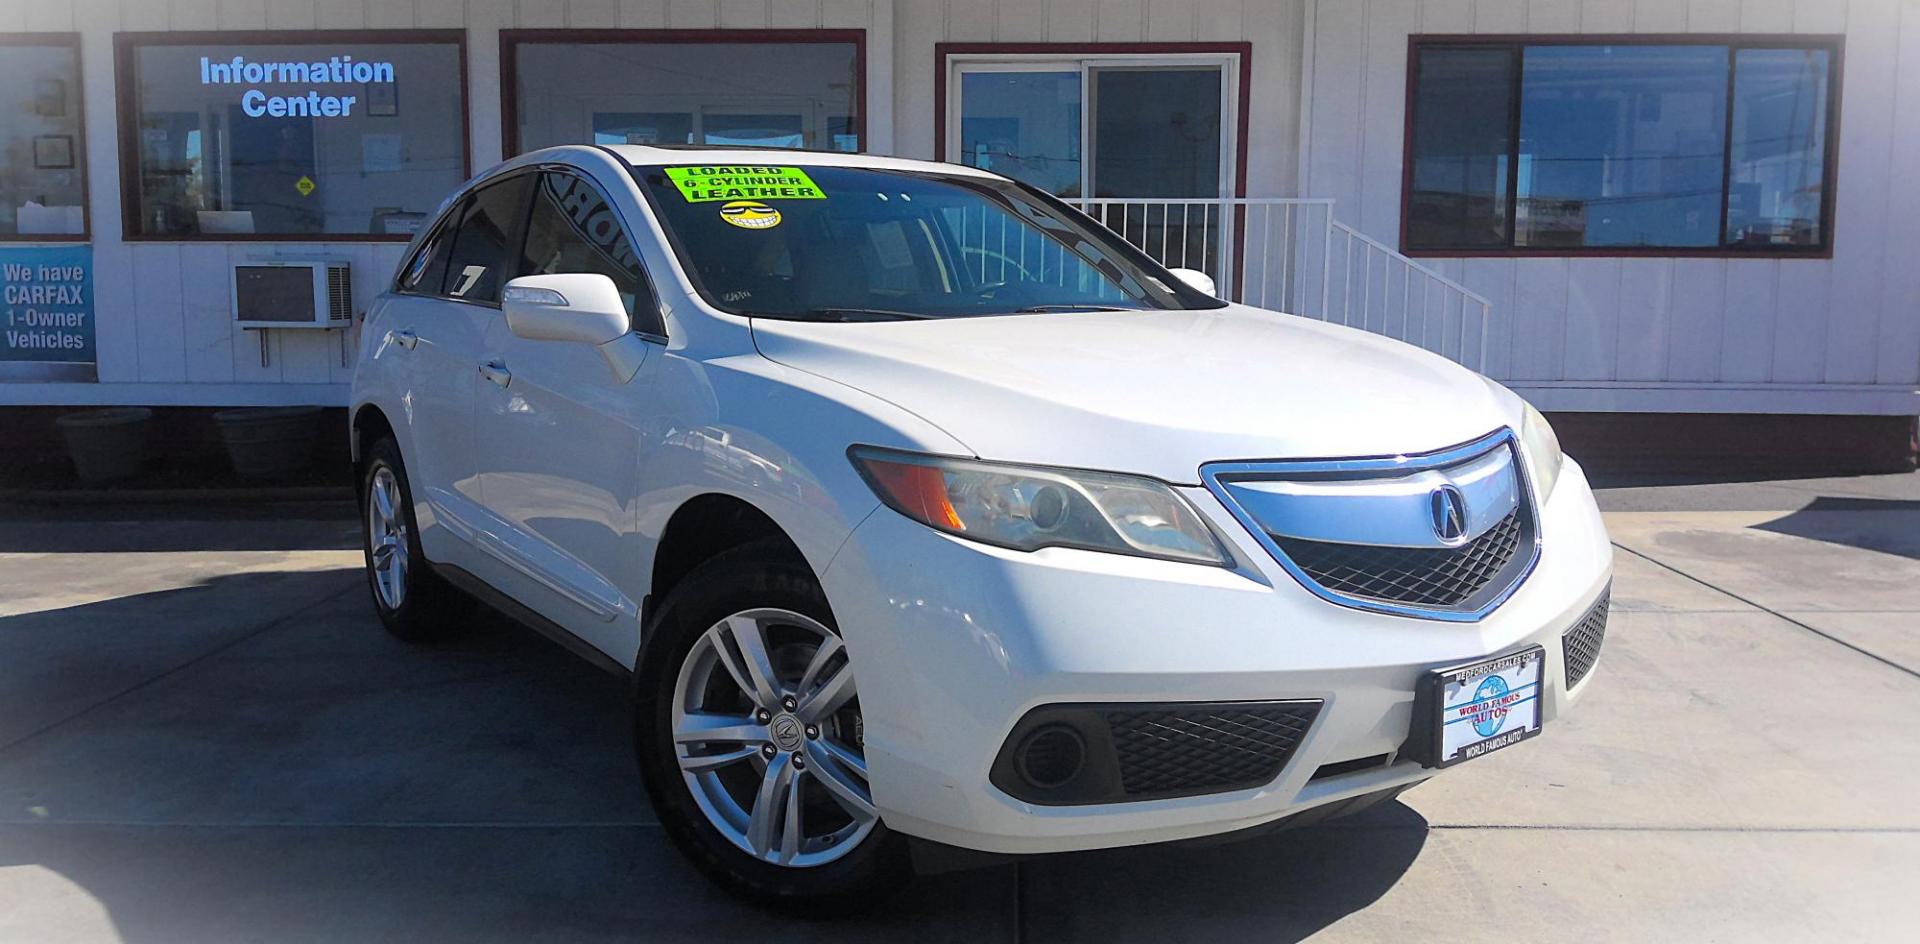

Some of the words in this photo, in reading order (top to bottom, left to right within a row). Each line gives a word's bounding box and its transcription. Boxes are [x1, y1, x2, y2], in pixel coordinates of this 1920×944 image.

[200, 56, 394, 84] Information
[242, 89, 356, 117] Center
[688, 167, 782, 176] LOADED
[692, 187, 814, 199] LEATHER
[3, 263, 32, 281] We
[39, 263, 84, 281] have
[4, 285, 84, 304] CARFAX
[6, 308, 85, 326] 1-Owner
[6, 330, 84, 349] Vehicles
[1459, 702, 1489, 717] WORLD
[1491, 692, 1521, 709] FAMOUS
[1465, 742, 1485, 759] WORLD
[1485, 734, 1507, 752] FAMOUS
